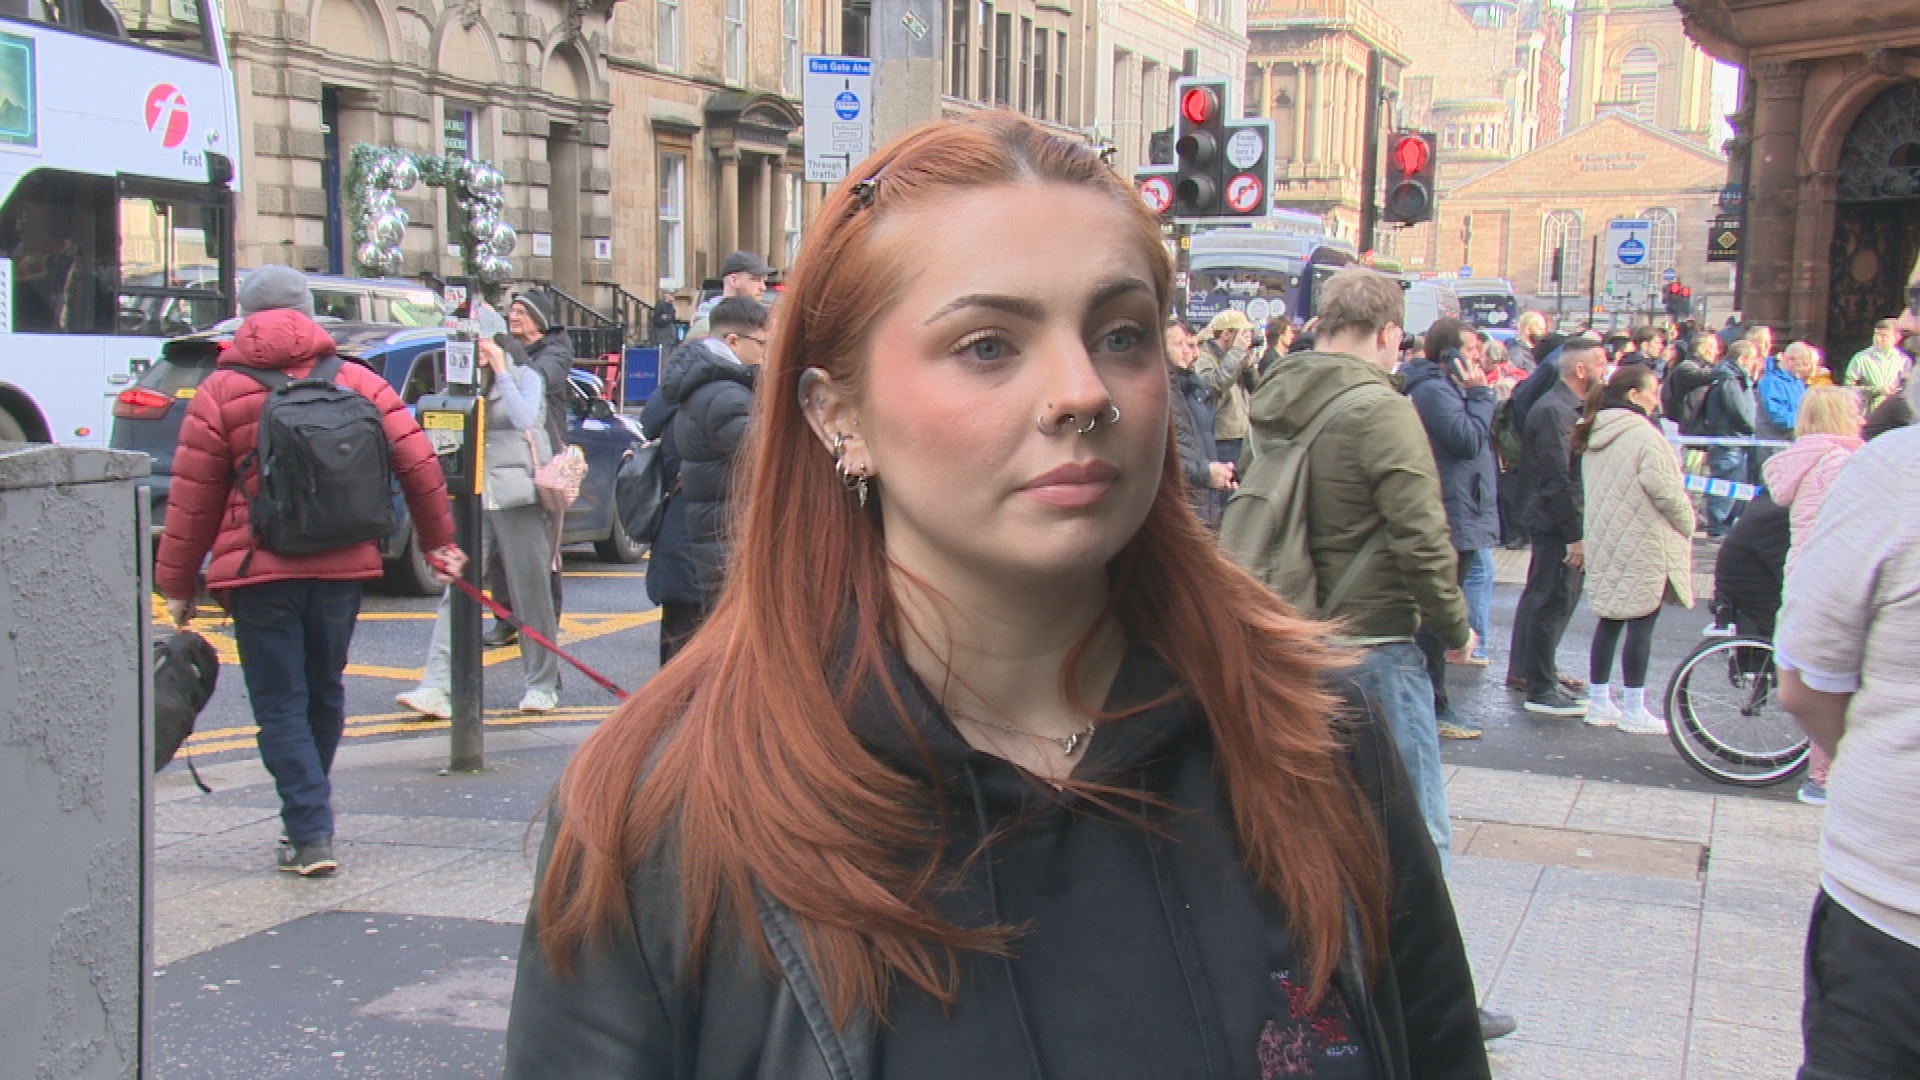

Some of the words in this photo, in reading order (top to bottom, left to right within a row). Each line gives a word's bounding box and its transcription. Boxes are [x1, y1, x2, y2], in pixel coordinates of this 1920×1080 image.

[811, 61, 828, 71] Bus
[829, 61, 851, 72] Gate
[182, 150, 202, 168] First
[807, 159, 843, 171] Through
[811, 170, 838, 179] traffic
